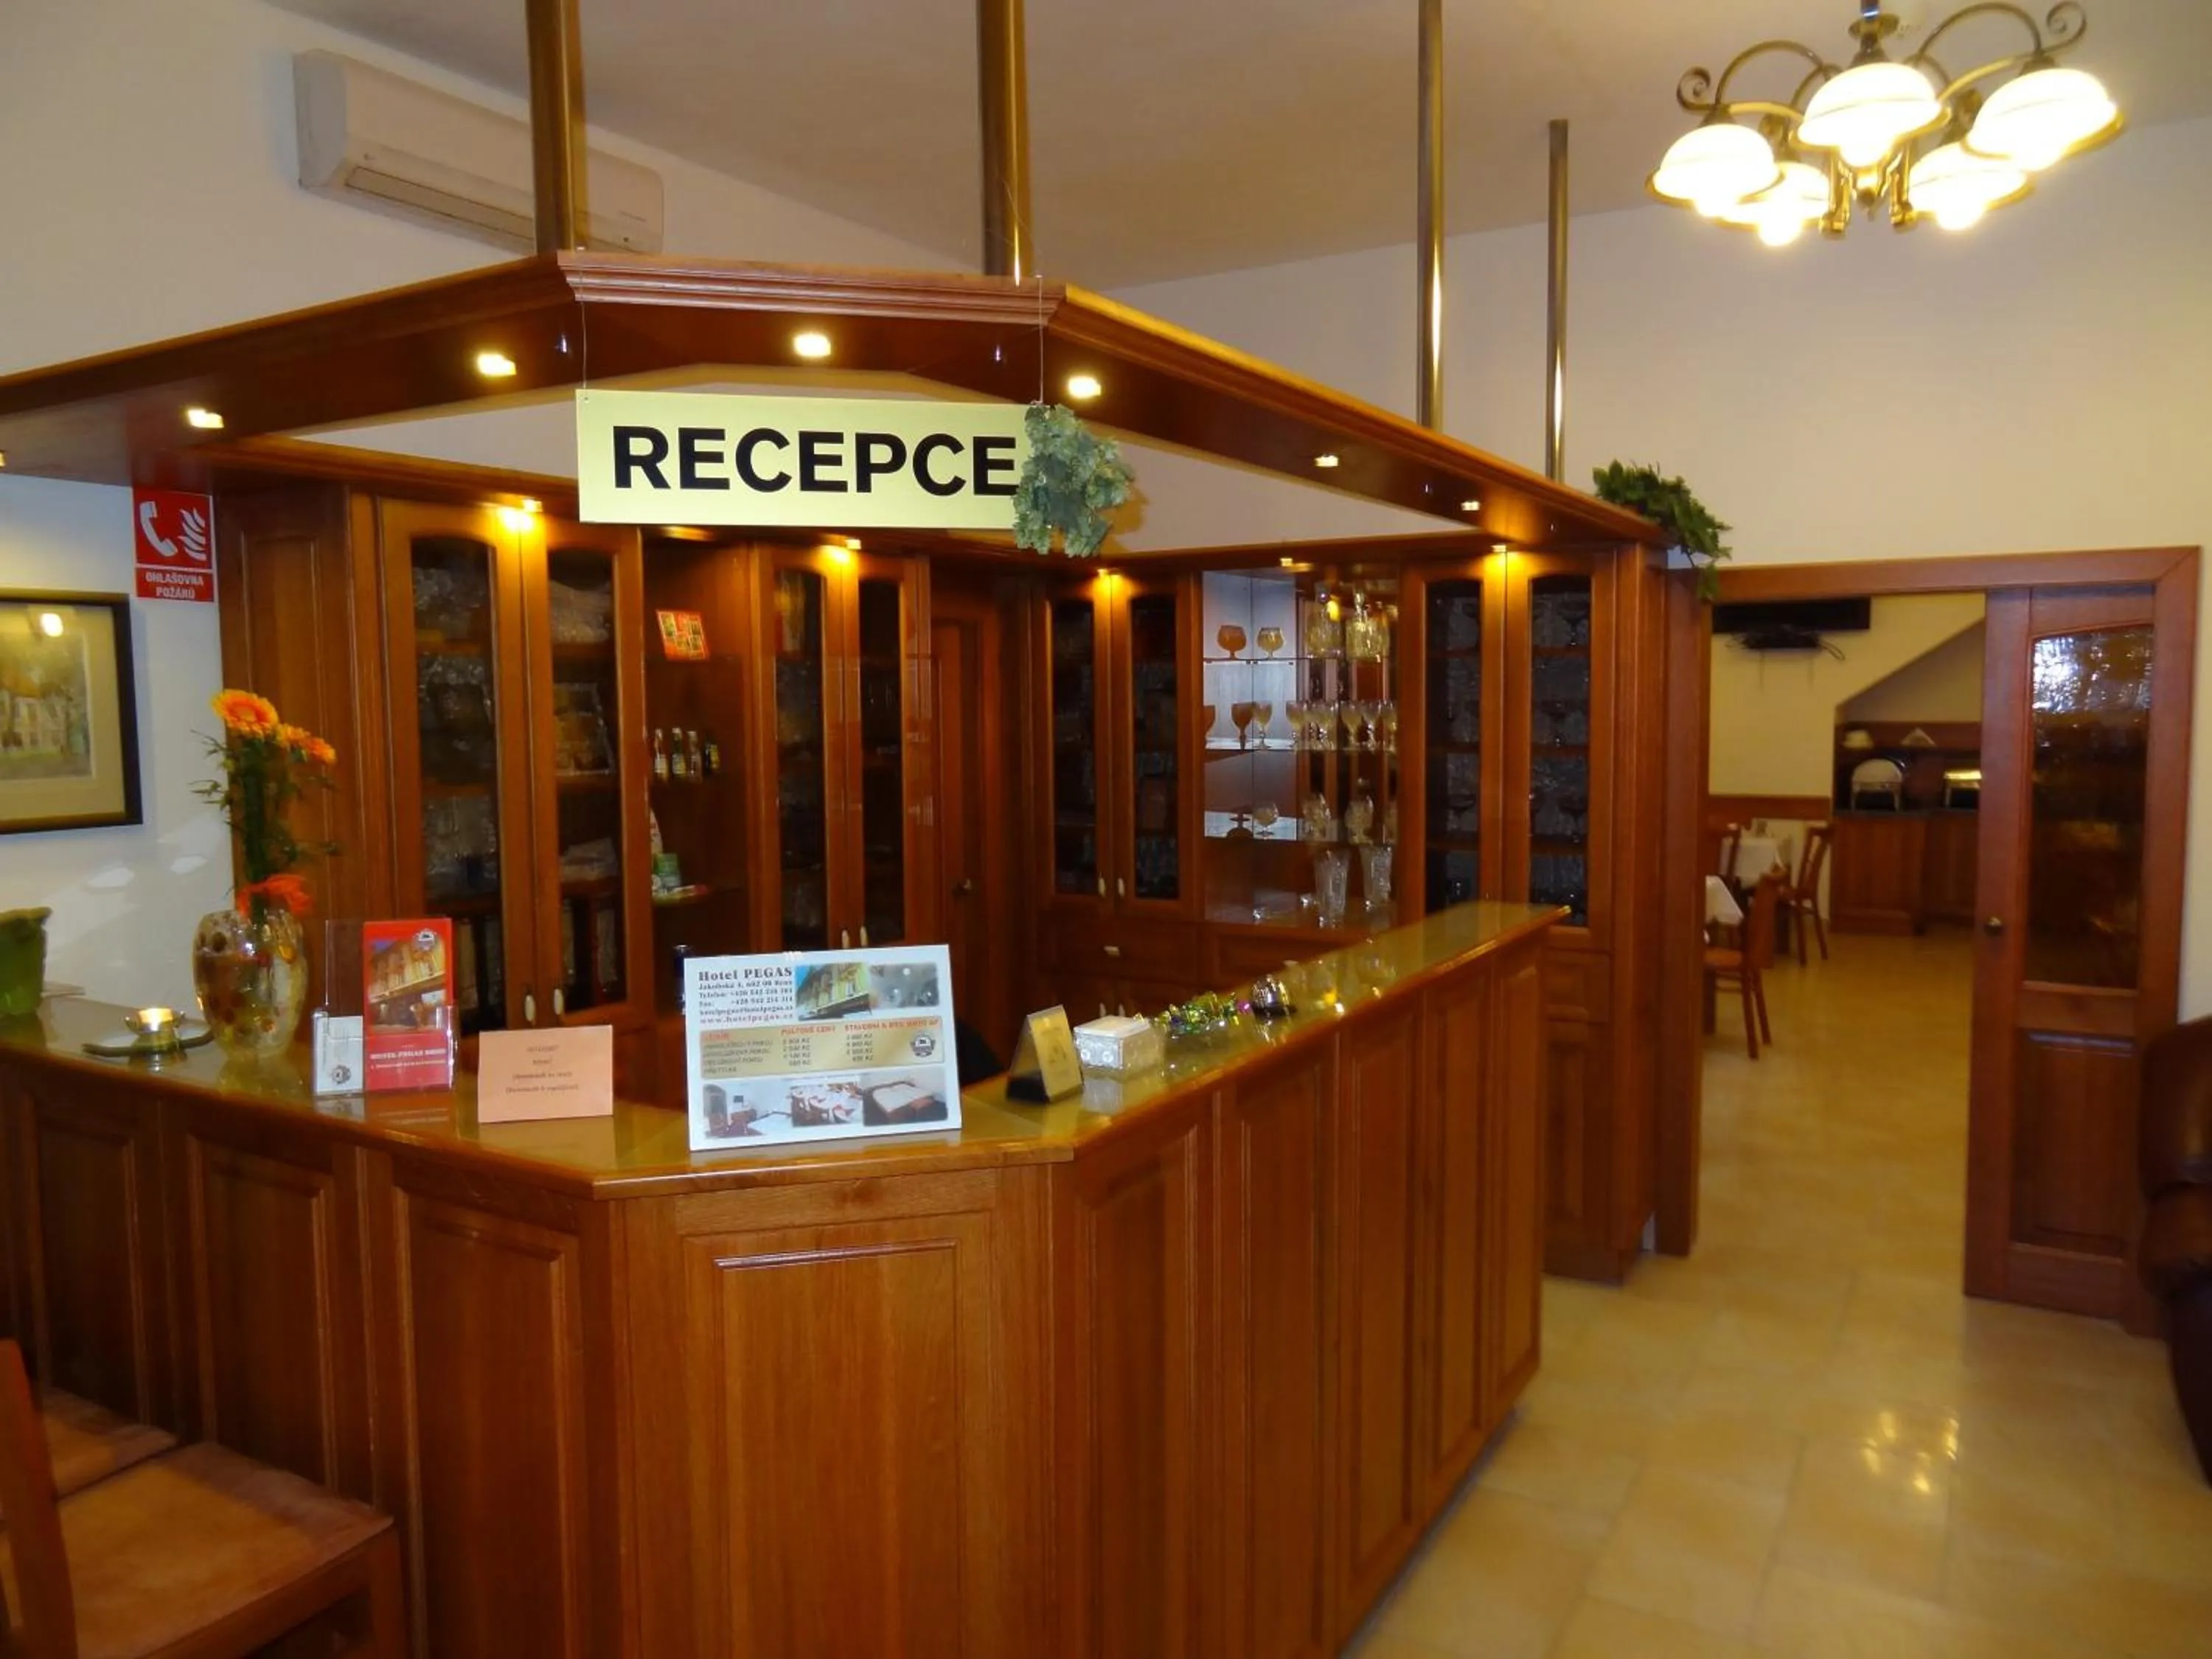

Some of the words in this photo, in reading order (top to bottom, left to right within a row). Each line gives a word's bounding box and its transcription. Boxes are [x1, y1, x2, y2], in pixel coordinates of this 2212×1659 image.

[613, 425, 1020, 497] RECEPCE
[145, 571, 204, 585] OHLAŠOVNA
[698, 969, 738, 981] Hotel
[744, 966, 793, 979] PEGAS
